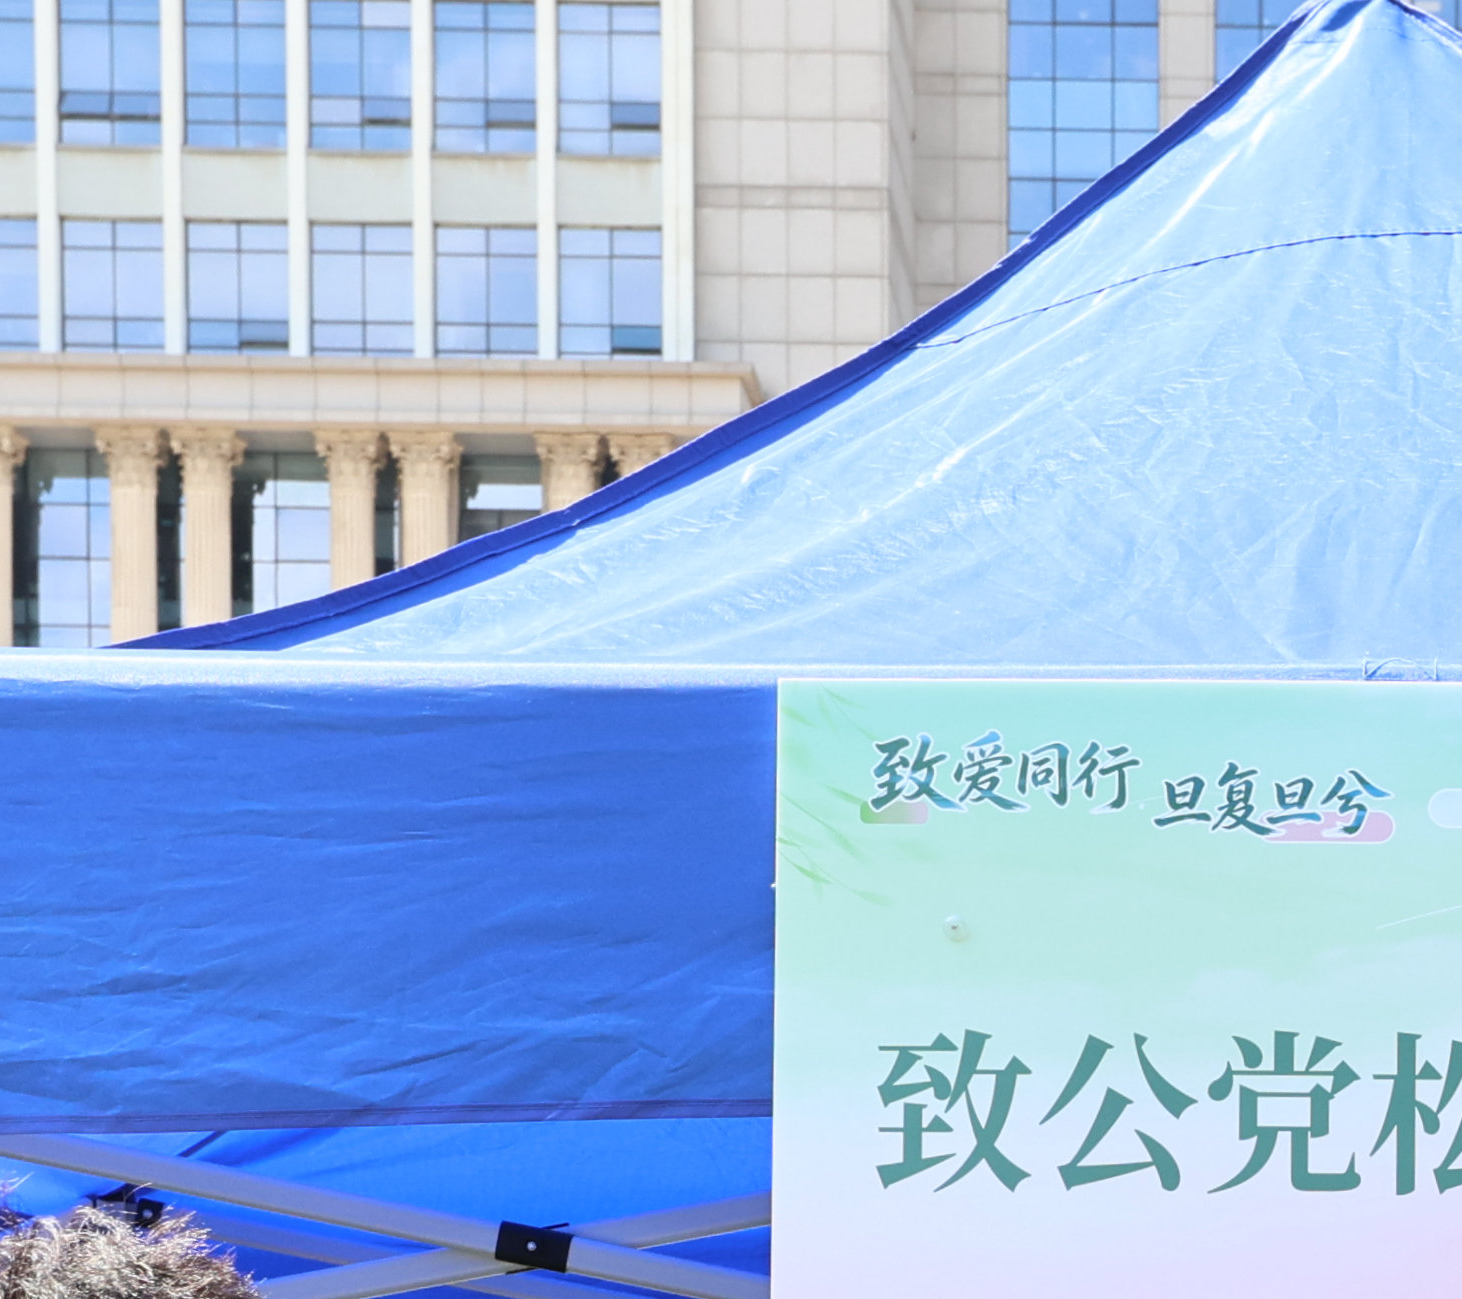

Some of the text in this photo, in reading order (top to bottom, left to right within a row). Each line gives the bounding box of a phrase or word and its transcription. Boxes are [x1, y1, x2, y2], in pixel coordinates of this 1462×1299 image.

[869, 730, 1394, 838] 致爱同行 旦复旦兮
